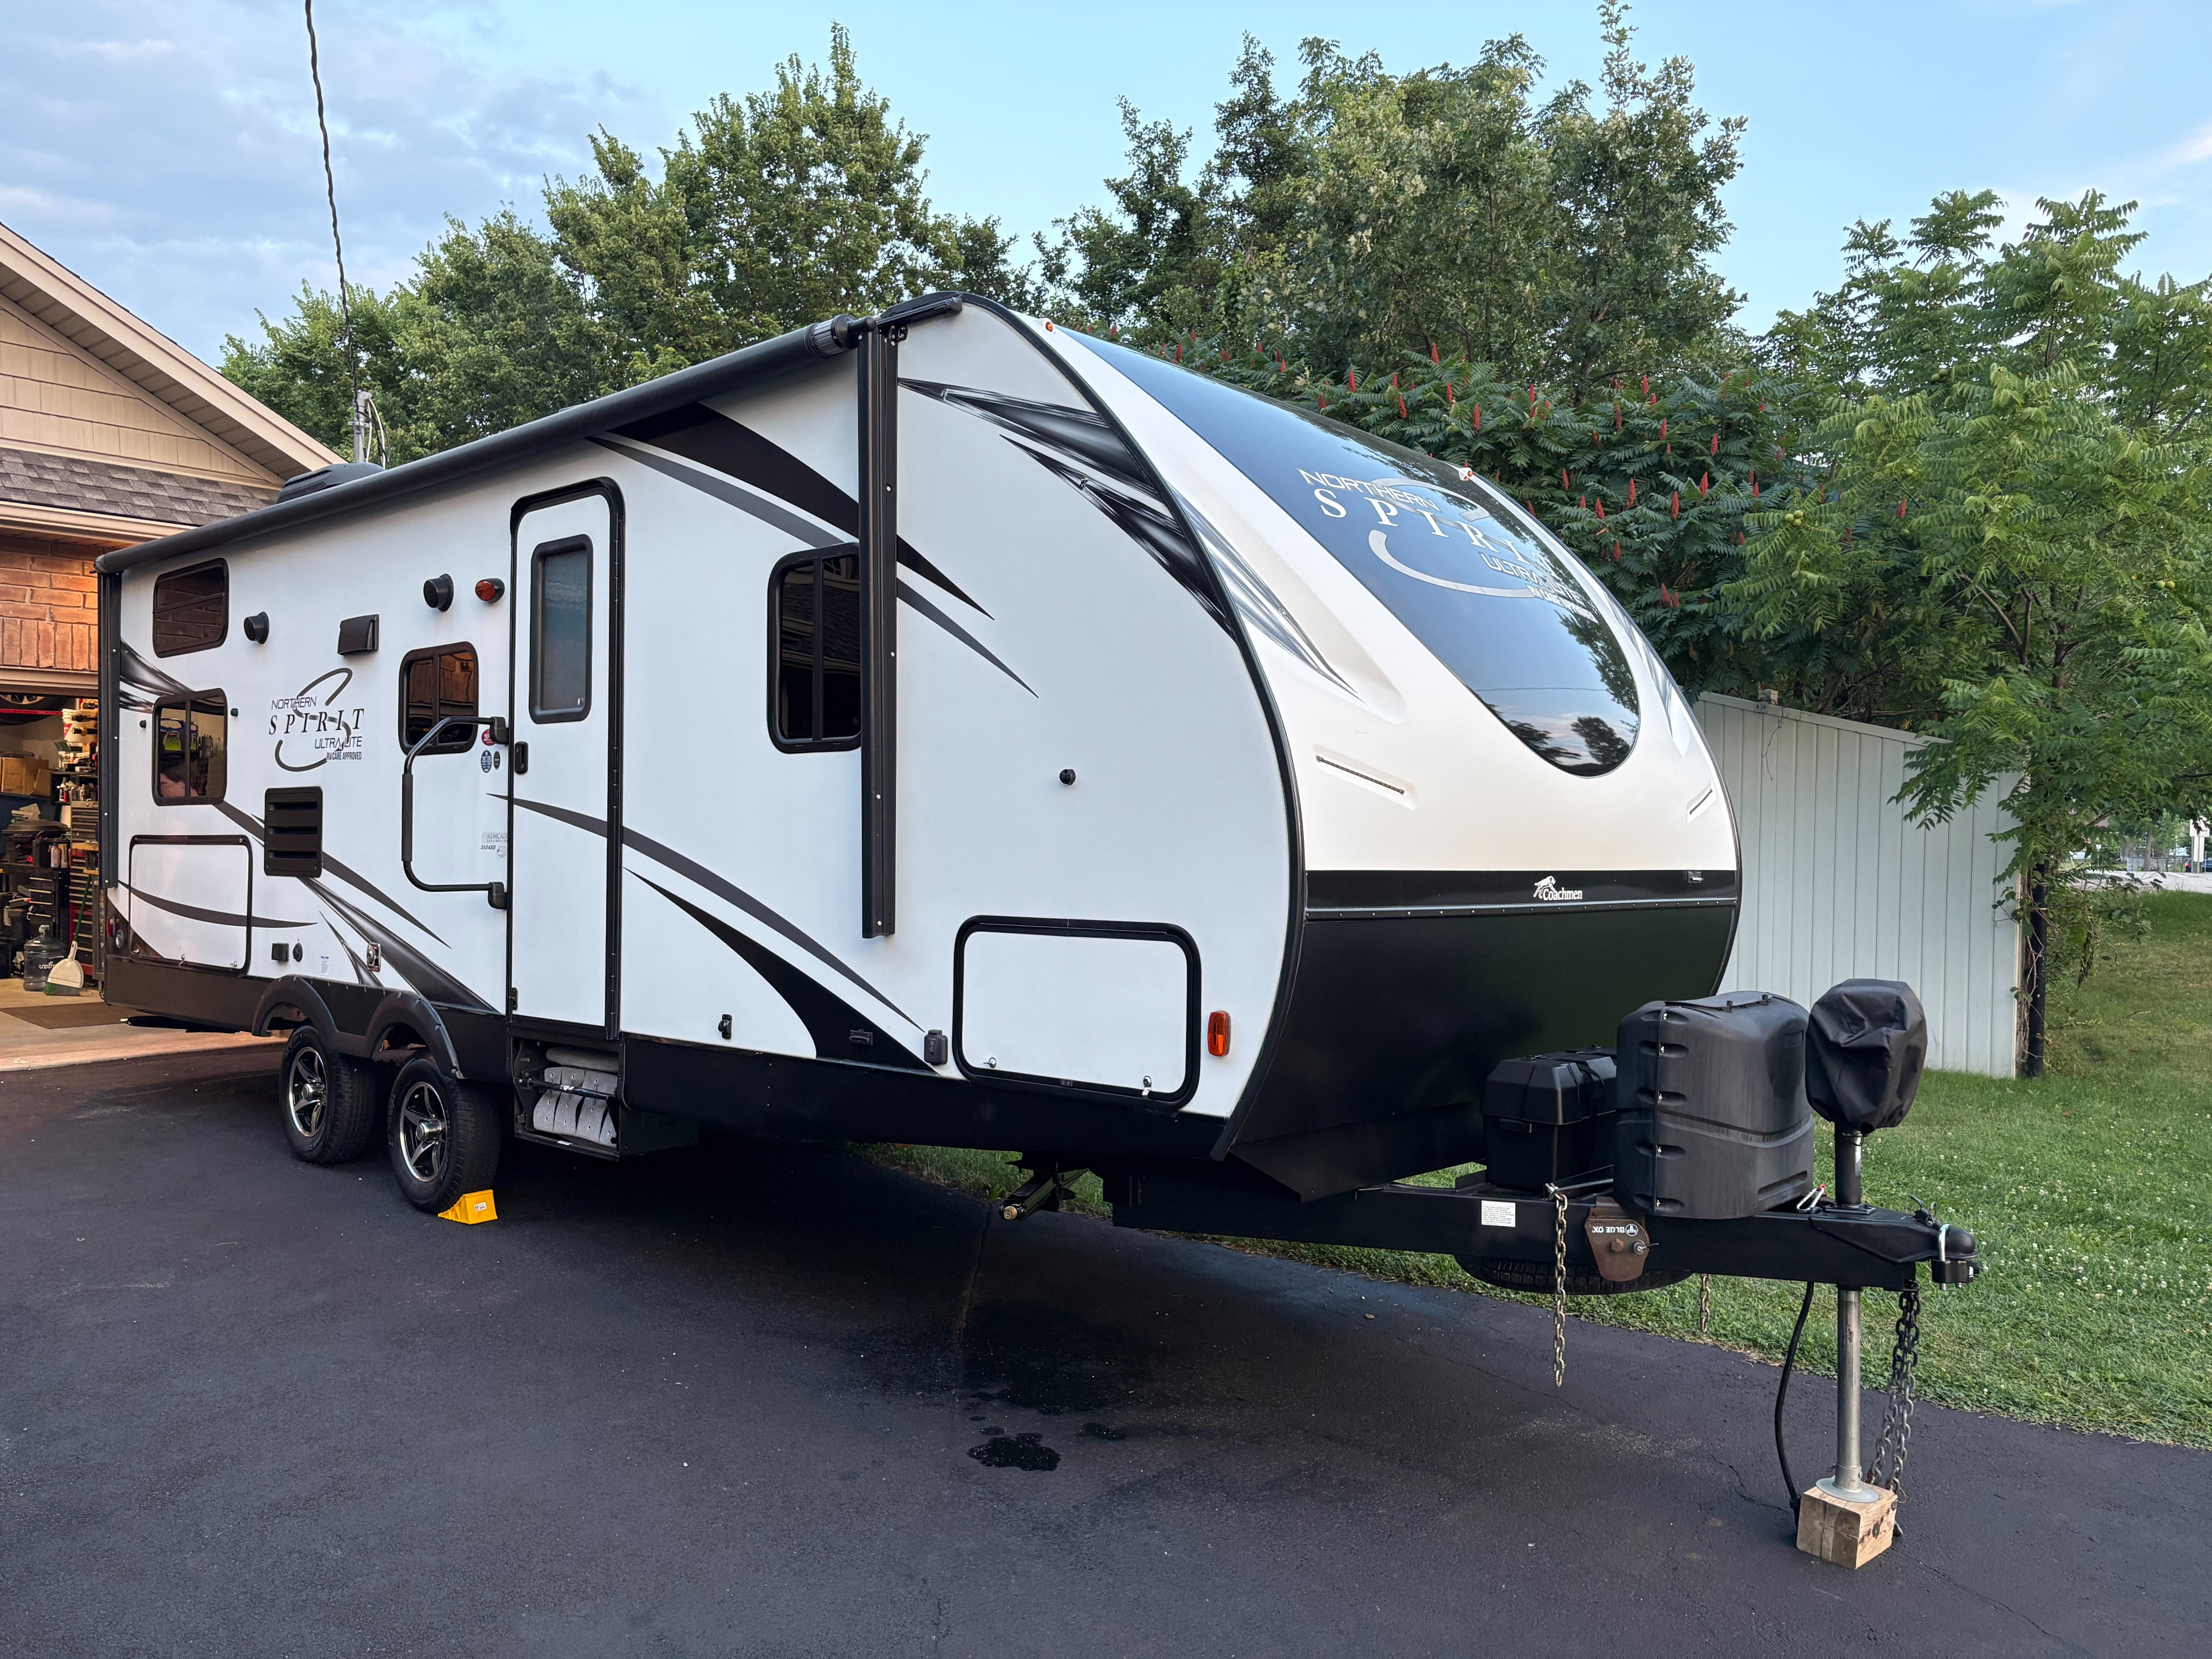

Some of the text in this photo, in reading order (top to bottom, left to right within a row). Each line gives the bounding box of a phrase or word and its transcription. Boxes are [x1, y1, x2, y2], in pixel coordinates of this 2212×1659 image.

[1297, 468, 1441, 512] NORTHERN
[1314, 488, 1563, 582] SPIRIT
[1479, 553, 1548, 588] ULTRA
[272, 696, 317, 709] NORTHERN
[269, 708, 364, 735] SPIRIT
[315, 736, 363, 749] ULTRA LITE
[327, 752, 362, 760] RV CARE APPROVED
[1543, 887, 1583, 901] Coachmen
